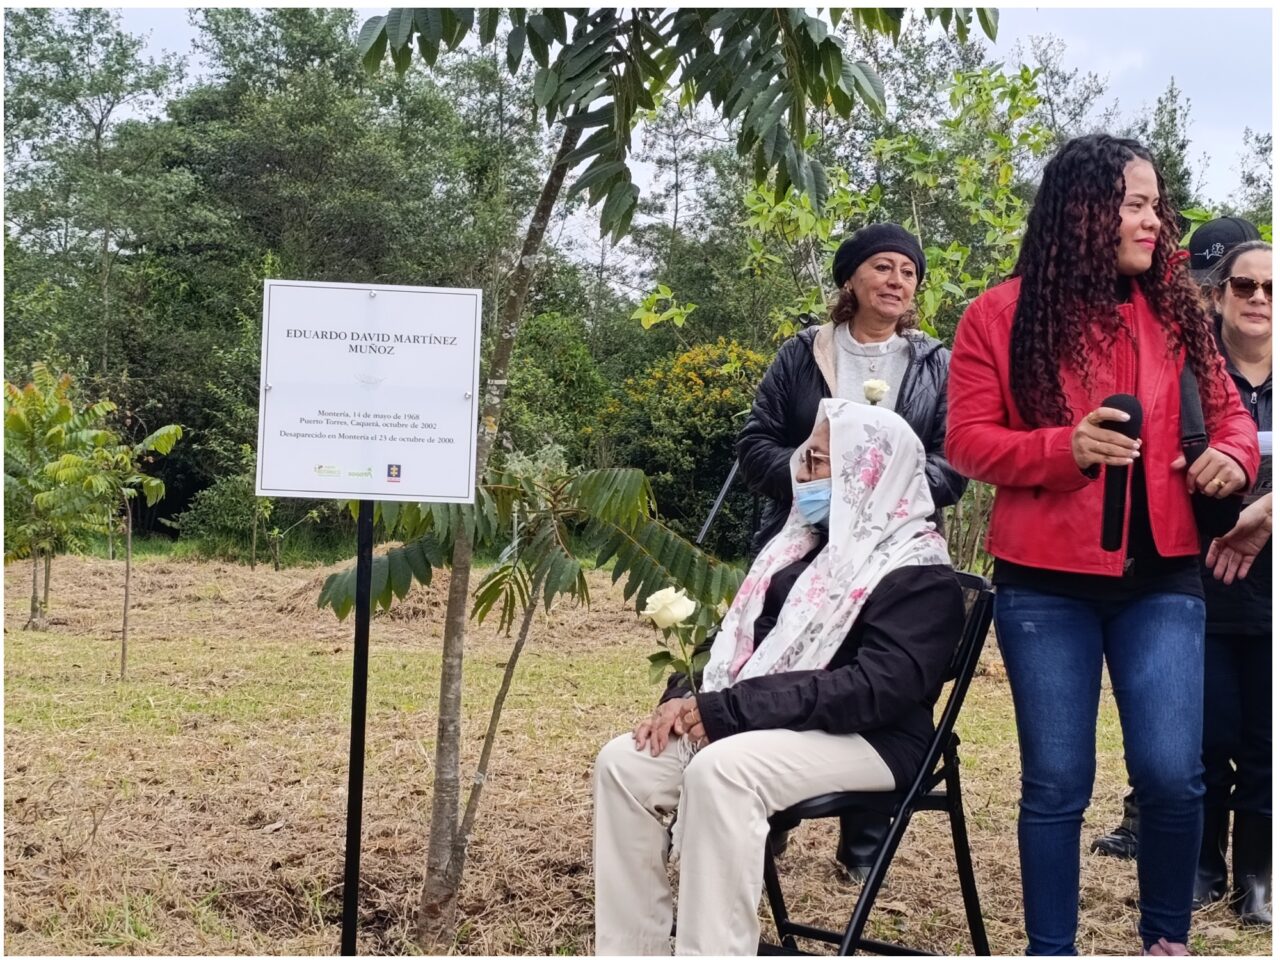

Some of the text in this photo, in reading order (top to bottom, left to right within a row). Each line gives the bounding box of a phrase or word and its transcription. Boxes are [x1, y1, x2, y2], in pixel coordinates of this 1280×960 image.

[286, 329, 458, 346] EDUARDO DAVID MARTÍNEZ
[348, 344, 395, 355] MUÑOZ
[318, 410, 351, 418] Montería,
[299, 417, 323, 425] Puerto
[279, 430, 326, 439] Desaparecido
[389, 434, 398, 442] de
[399, 435, 425, 443] octubre
